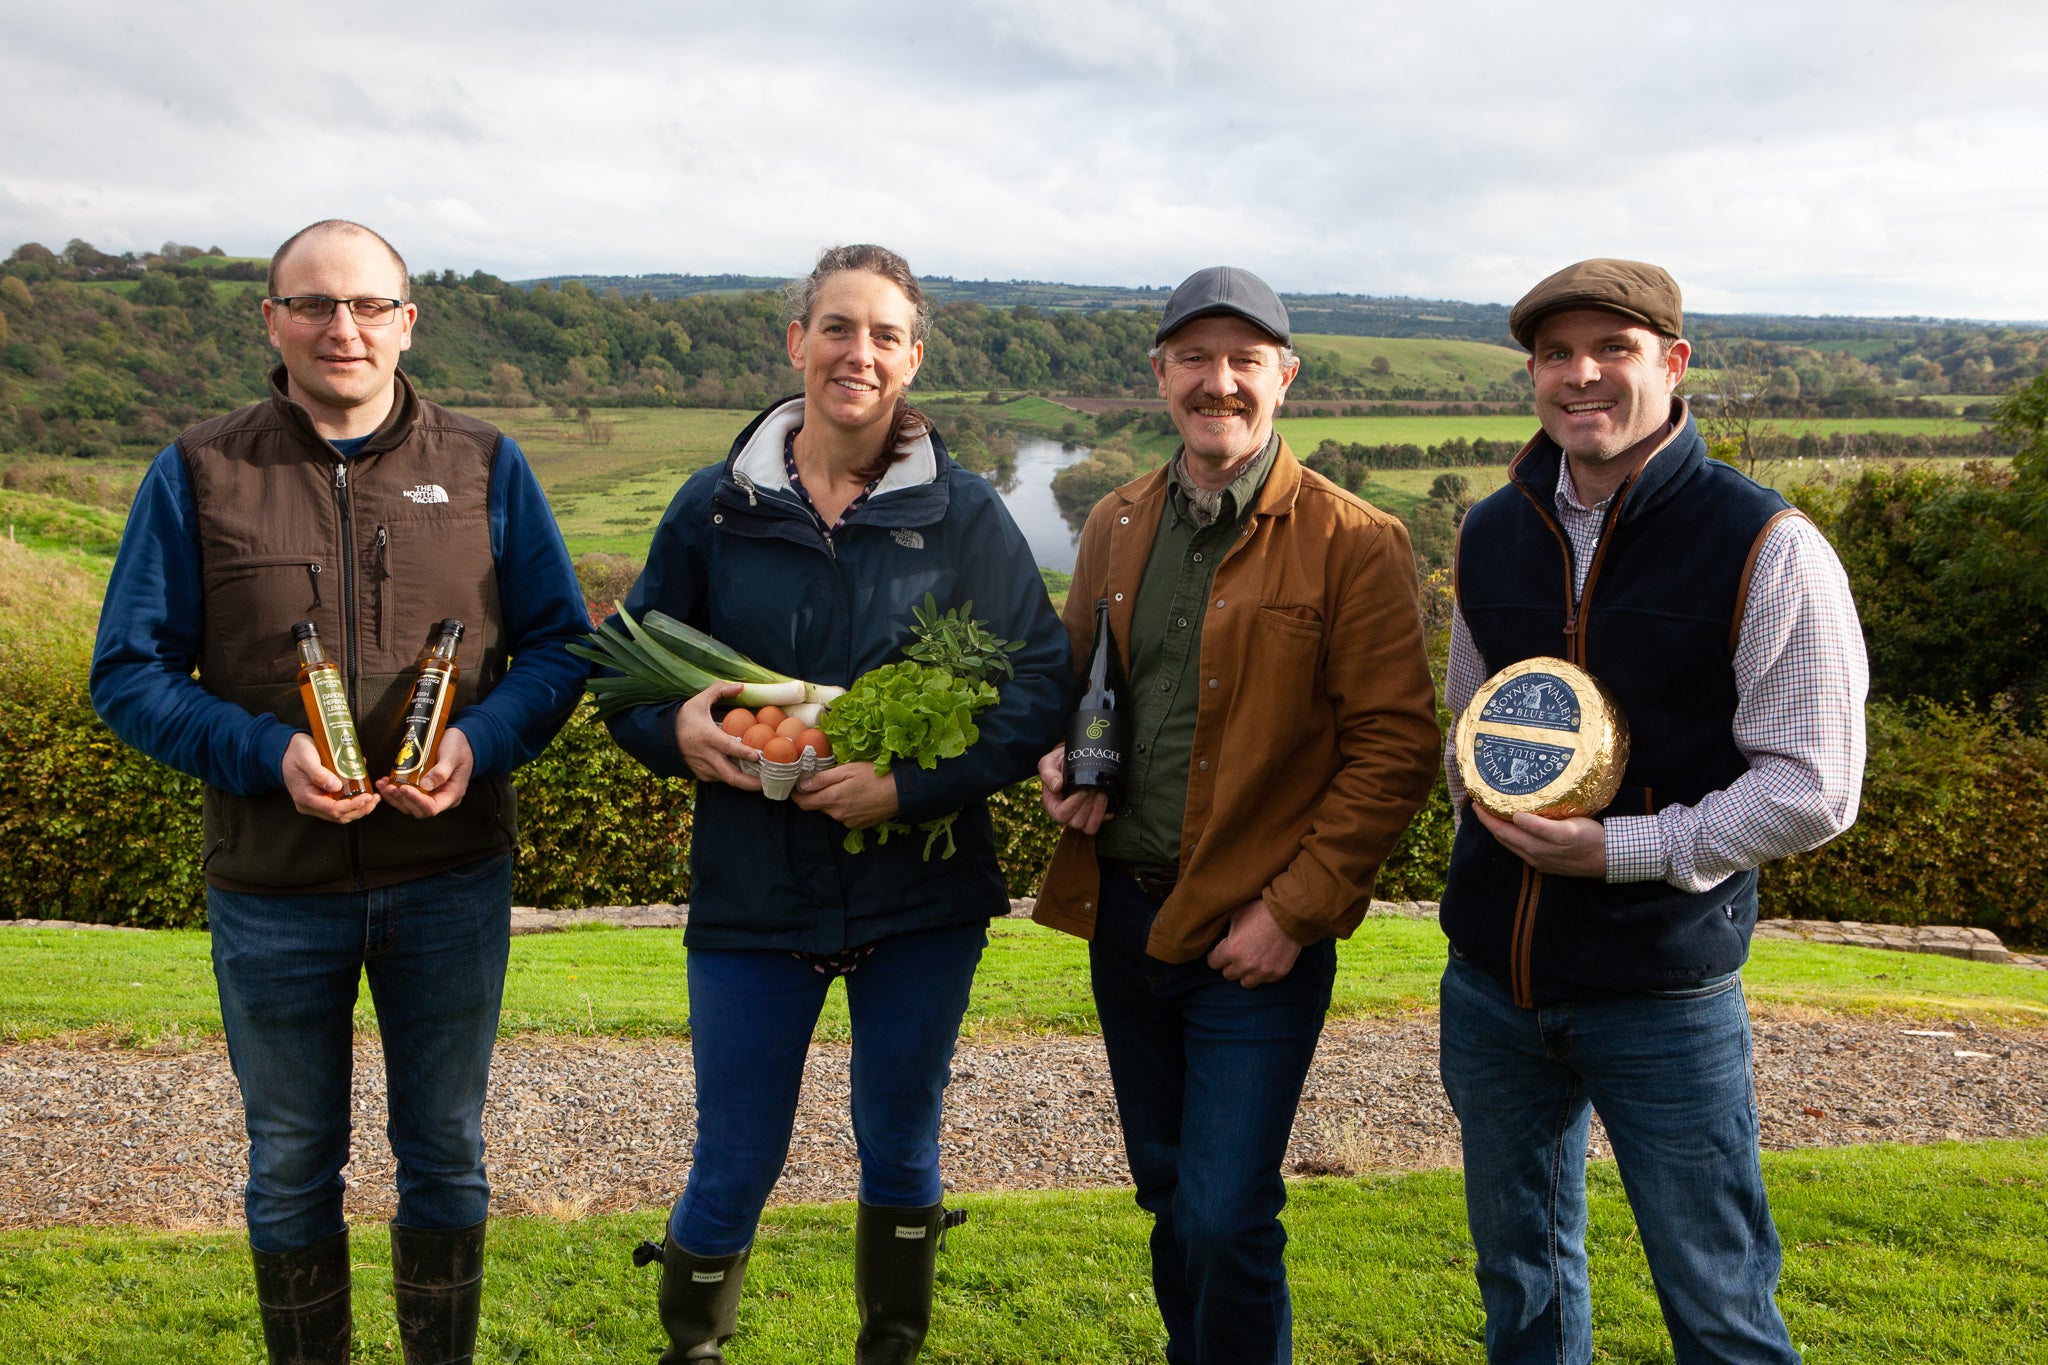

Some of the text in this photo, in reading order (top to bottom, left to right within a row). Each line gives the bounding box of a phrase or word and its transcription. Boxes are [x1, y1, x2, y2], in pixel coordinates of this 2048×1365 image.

[403, 490, 434, 498] NORTH
[890, 530, 912, 542] NORTH
[901, 528, 913, 537] THE
[895, 538, 912, 547] FACE
[1493, 682, 1571, 722] BOYNE VALLEY
[1516, 708, 1546, 720] BLUE
[1067, 747, 1121, 763] COCKAGEE
[1507, 747, 1536, 760] BLUE
[1483, 743, 1560, 786] BOYNE VALLEY
